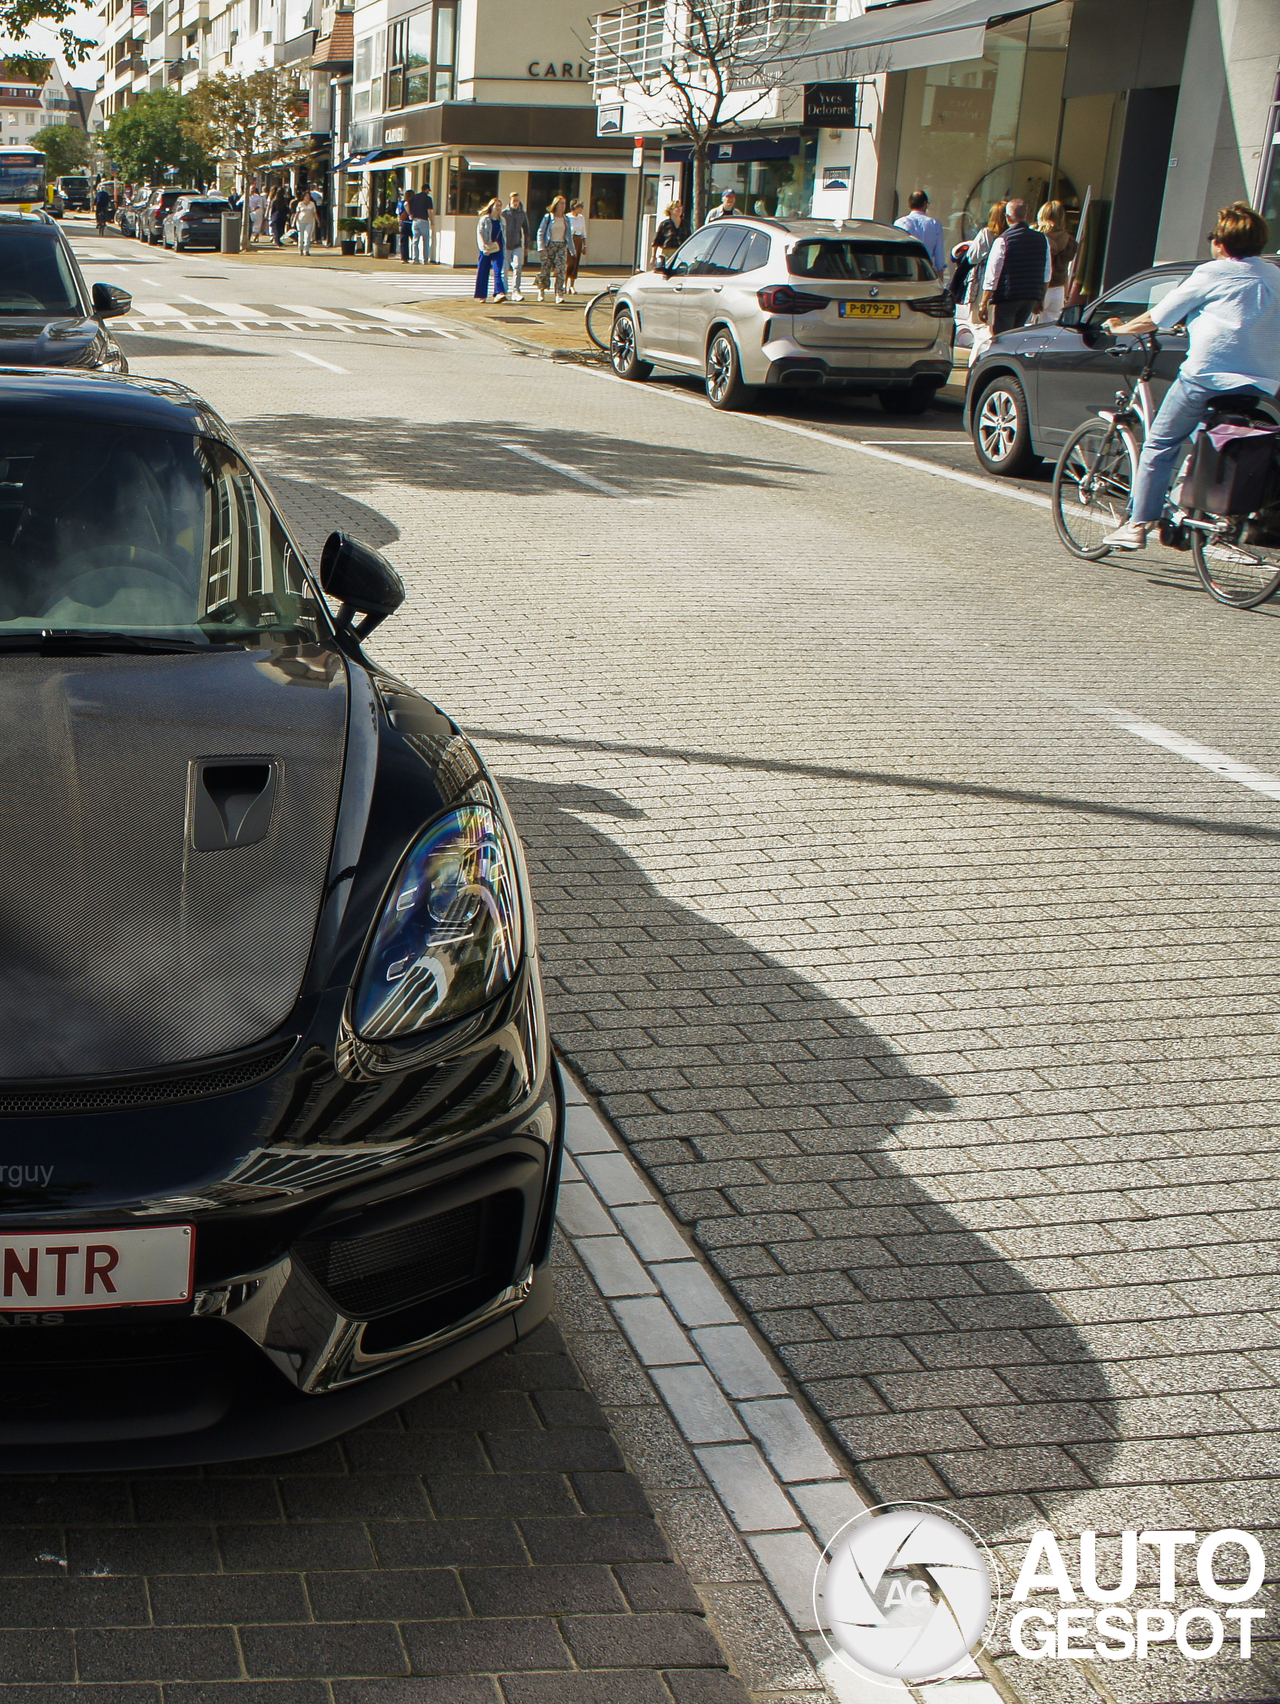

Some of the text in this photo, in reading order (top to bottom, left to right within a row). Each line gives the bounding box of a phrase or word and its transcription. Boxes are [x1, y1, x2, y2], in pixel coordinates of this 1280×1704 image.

[819, 92, 842, 103] Yves
[807, 104, 853, 115] Delorme
[850, 303, 895, 314] P-879-ZP
